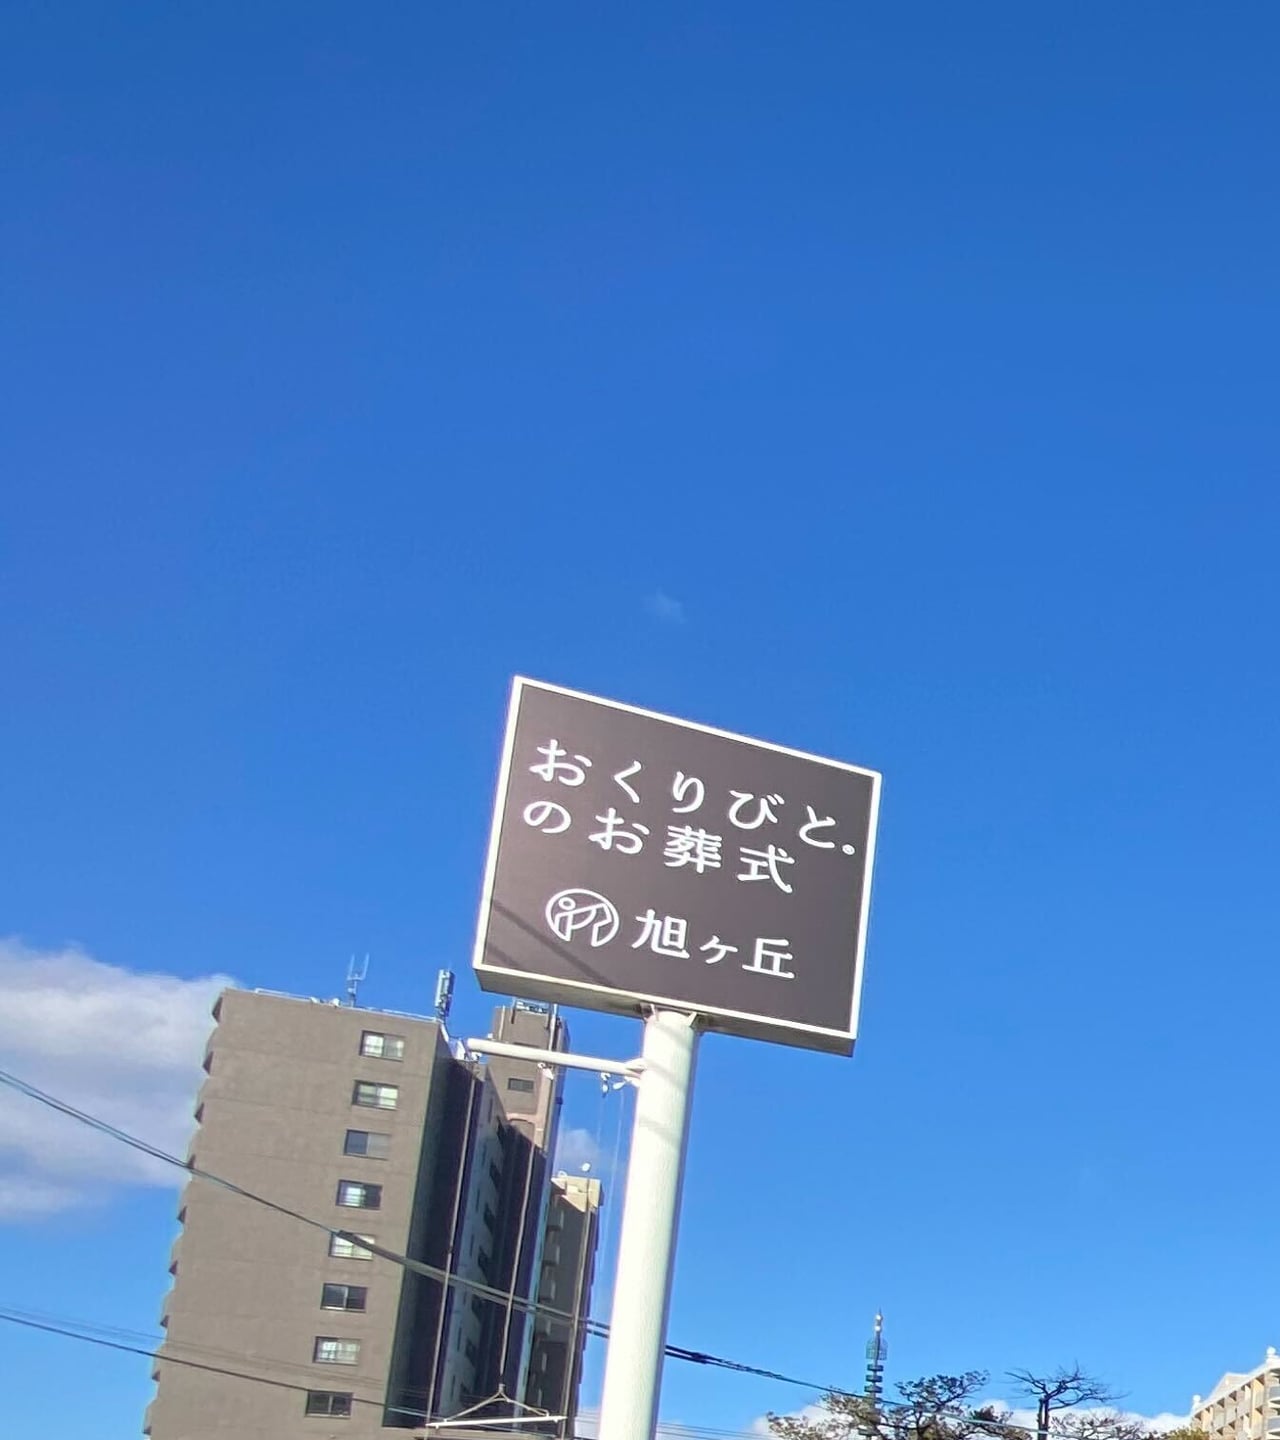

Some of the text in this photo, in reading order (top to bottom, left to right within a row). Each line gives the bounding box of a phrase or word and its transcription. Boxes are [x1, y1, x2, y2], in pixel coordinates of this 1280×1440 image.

[523, 799, 796, 894] のお葬式
[631, 908, 796, 981] 旭ヶ丘
